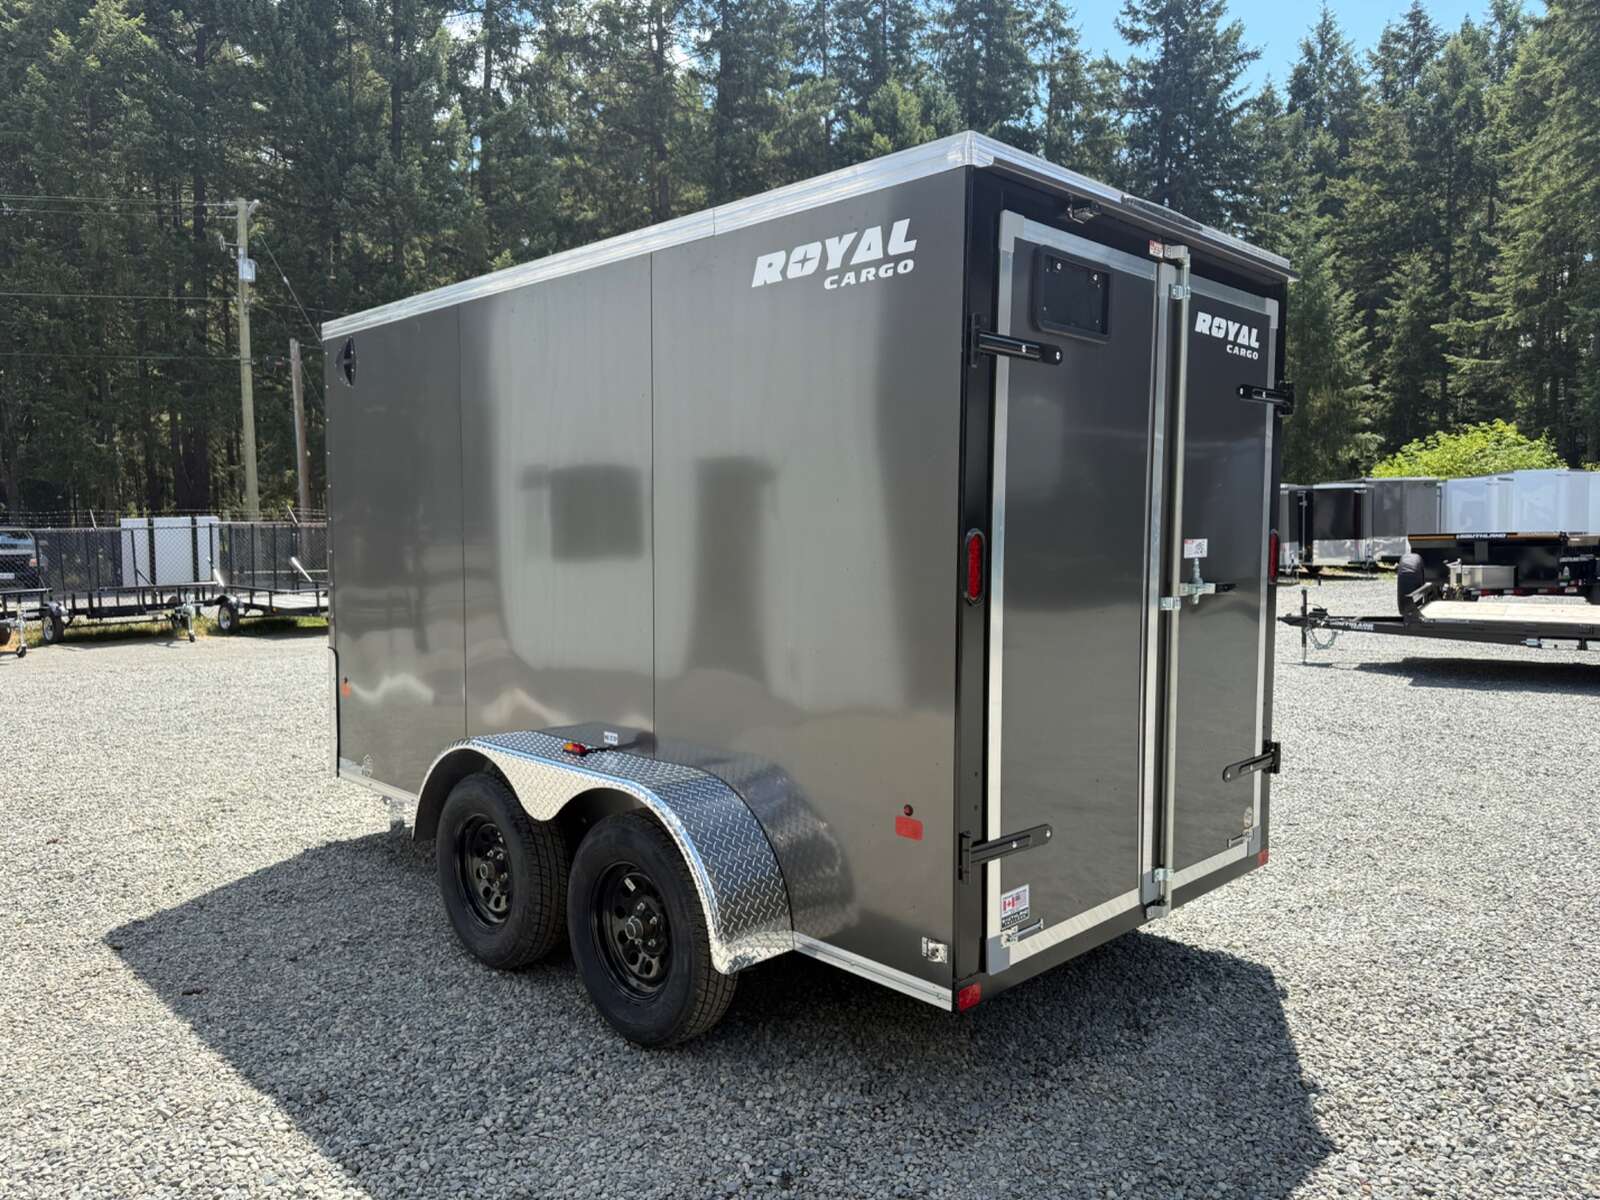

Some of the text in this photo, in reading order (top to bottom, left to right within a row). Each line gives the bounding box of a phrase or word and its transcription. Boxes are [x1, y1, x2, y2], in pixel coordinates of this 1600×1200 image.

[751, 218, 917, 288] ROYAL
[824, 259, 915, 290] CARGO
[1194, 311, 1260, 349] ROYAL
[1226, 344, 1259, 360] CARGO
